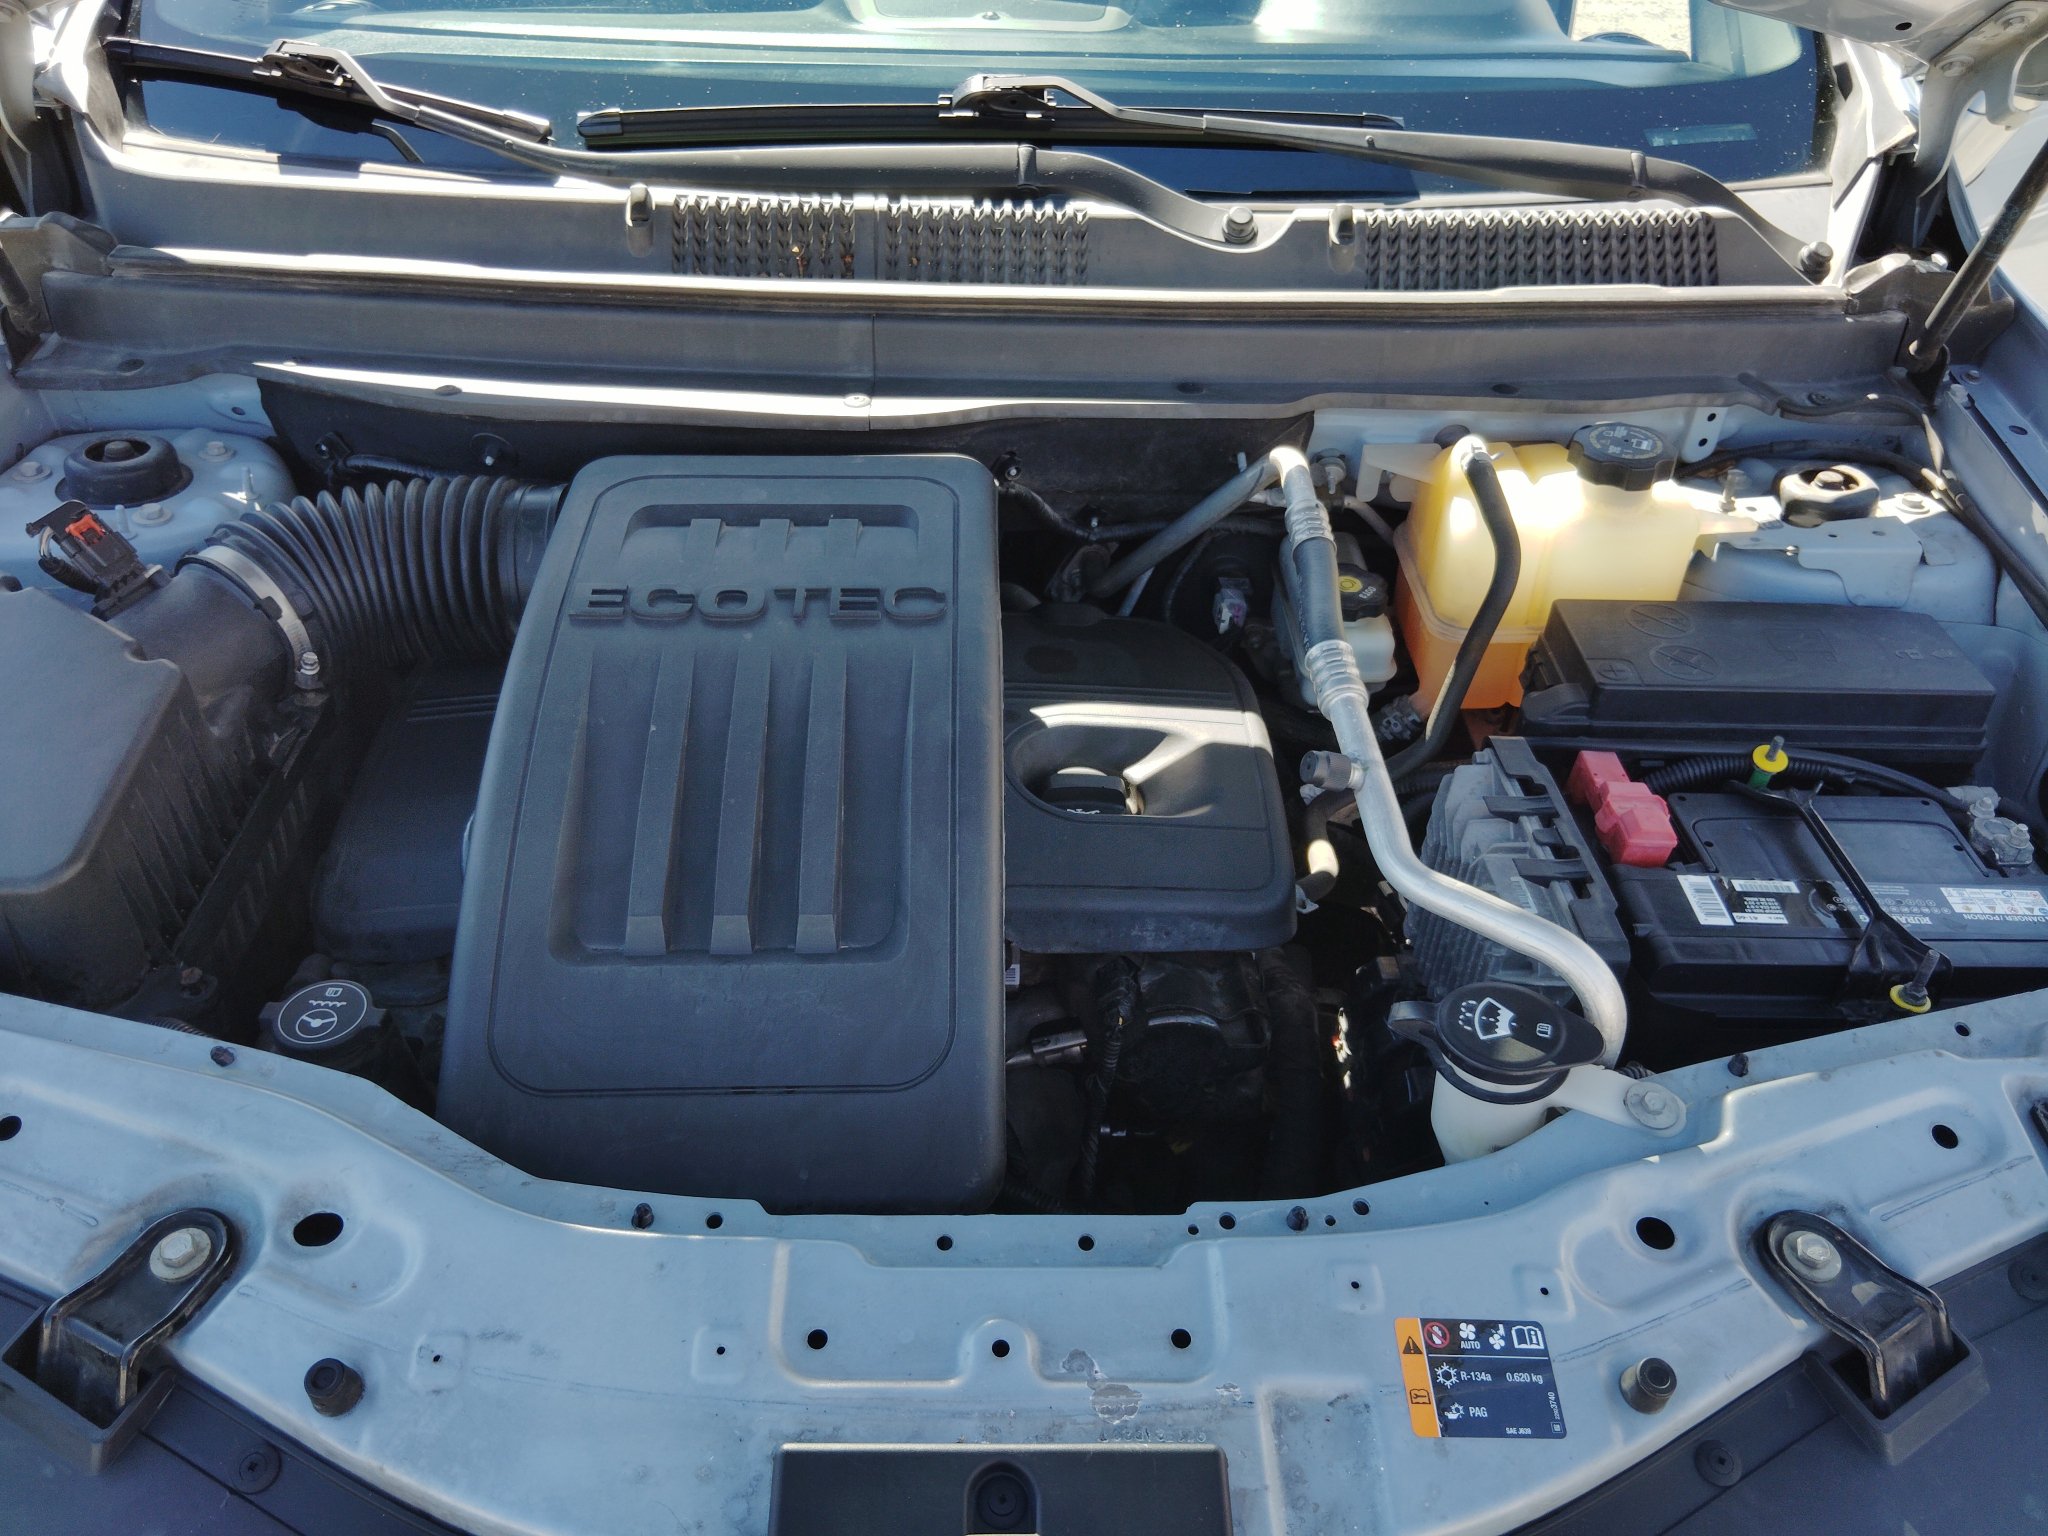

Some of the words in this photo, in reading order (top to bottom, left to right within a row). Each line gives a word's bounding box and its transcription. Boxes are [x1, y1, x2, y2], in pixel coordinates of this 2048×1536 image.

[568, 584, 948, 623] ECOTEC
[1460, 1340, 1480, 1350] AUTO
[1460, 1371, 1492, 1382] R-134a
[1506, 1372, 1530, 1382] 0.620
[1532, 1373, 1544, 1385] kg
[1469, 1406, 1488, 1418] PAG
[1505, 1427, 1517, 1435] SAE
